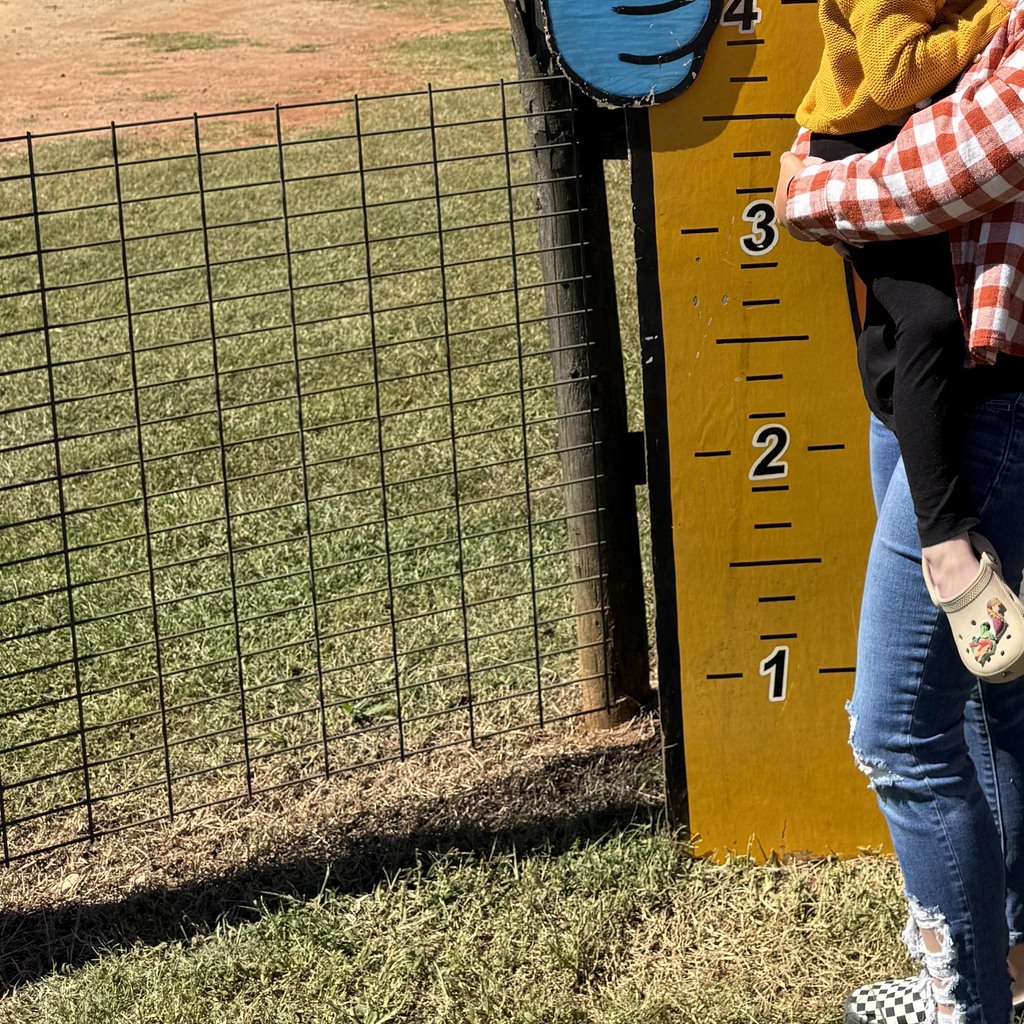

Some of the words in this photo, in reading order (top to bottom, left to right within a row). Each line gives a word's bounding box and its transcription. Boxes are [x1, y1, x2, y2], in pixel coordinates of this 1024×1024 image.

[740, 199, 779, 256] 3
[748, 423, 790, 480] 2
[759, 645, 789, 701] 1
